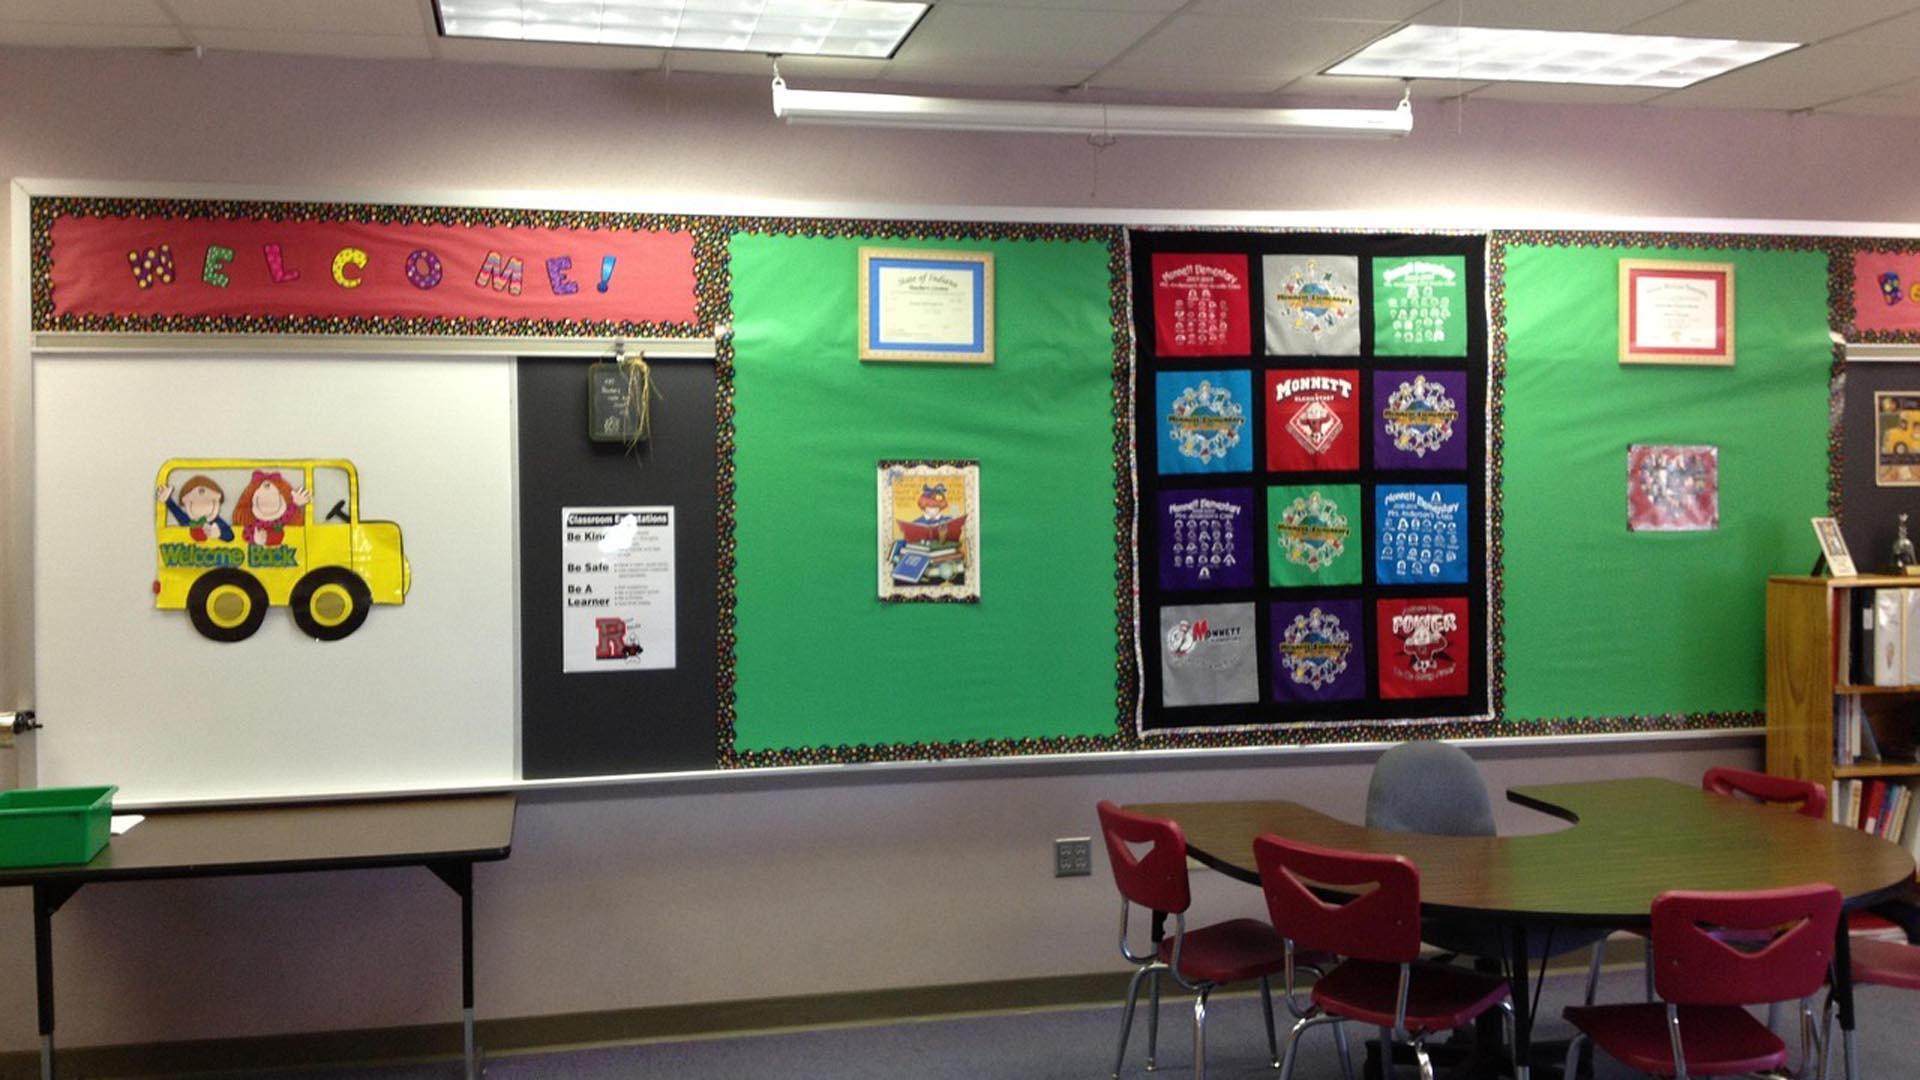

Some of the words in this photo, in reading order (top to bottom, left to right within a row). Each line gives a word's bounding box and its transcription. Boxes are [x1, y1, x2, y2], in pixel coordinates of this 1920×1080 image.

[126, 243, 617, 297] WELCOME!
[1194, 264, 1239, 285] Elementary
[1276, 376, 1352, 402] MONNETT
[567, 513, 614, 526] Classroom
[566, 531, 582, 542] Be
[584, 530, 606, 542] Kin
[159, 541, 246, 569] Welcome
[247, 541, 298, 568] Back
[567, 562, 582, 573] Be
[585, 561, 610, 573] Safe
[567, 584, 582, 594] Be
[585, 583, 593, 594] A
[567, 597, 610, 608] Learner
[1391, 611, 1458, 635] POWER
